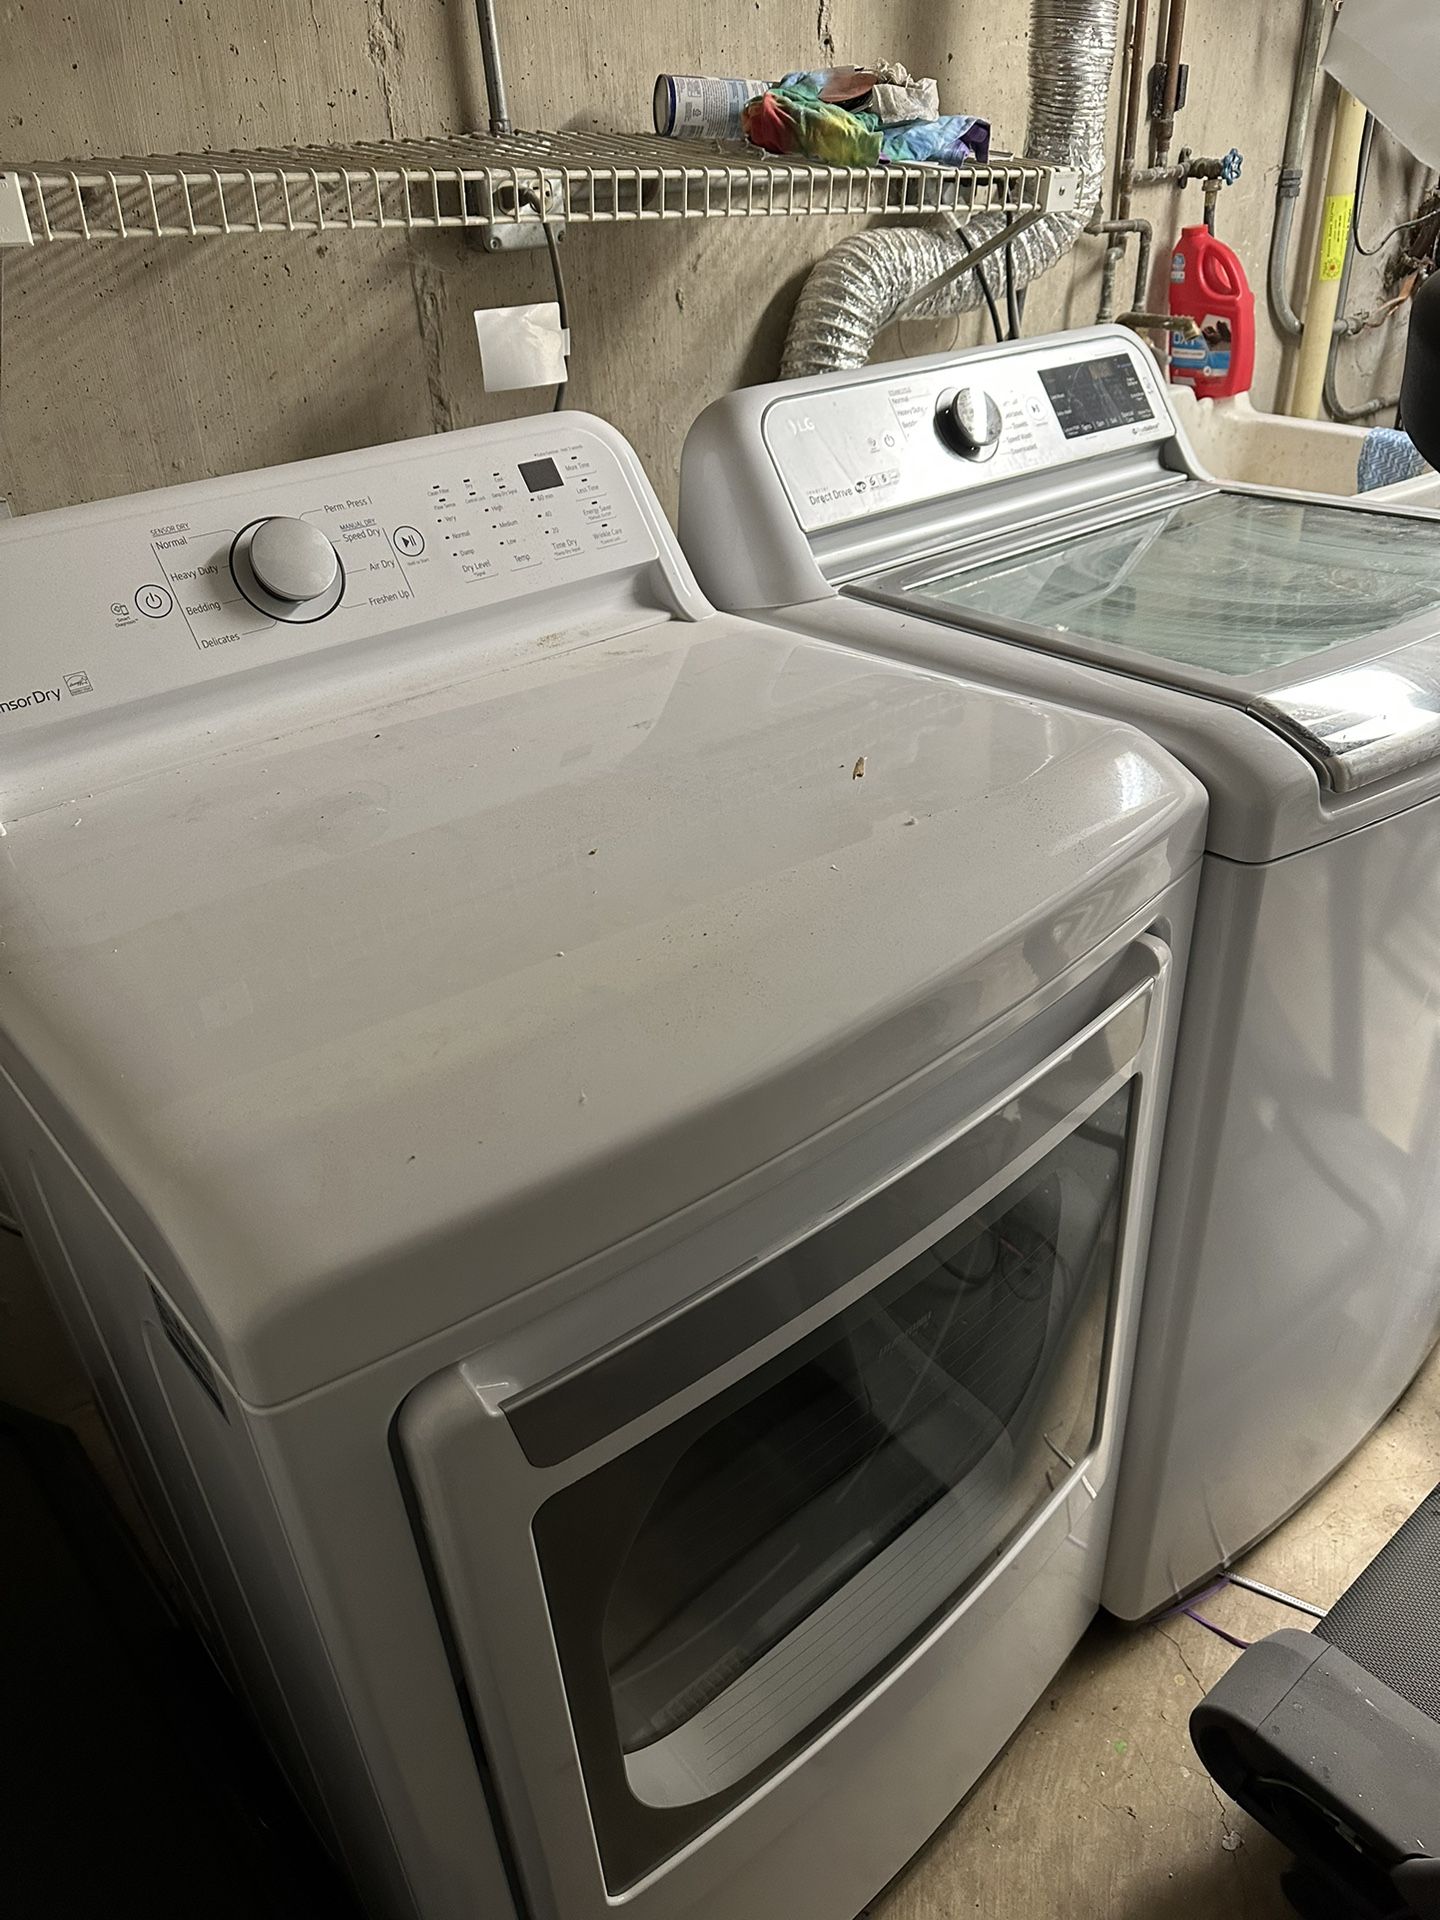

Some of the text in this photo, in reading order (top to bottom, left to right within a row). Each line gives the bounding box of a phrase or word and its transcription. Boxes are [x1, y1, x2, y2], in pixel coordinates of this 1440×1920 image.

[797, 416, 815, 432] LG
[345, 498, 368, 510] Press
[808, 487, 854, 506] Direct Drive
[582, 507, 599, 518] Energy
[150, 522, 190, 536] SENSOR DRY
[339, 517, 376, 531] MANUAL DRY
[155, 535, 188, 551] Normal
[342, 527, 381, 544] Speed Dry
[551, 542, 566, 551] Time
[565, 538, 578, 547] Dry
[369, 561, 380, 572] Air
[379, 558, 396, 569] Dry
[461, 559, 492, 573] Dry Level
[170, 564, 219, 583] Heavy Duty
[368, 588, 411, 607] Freshen Up
[186, 600, 222, 616] Bedding
[201, 632, 240, 649] Delicates
